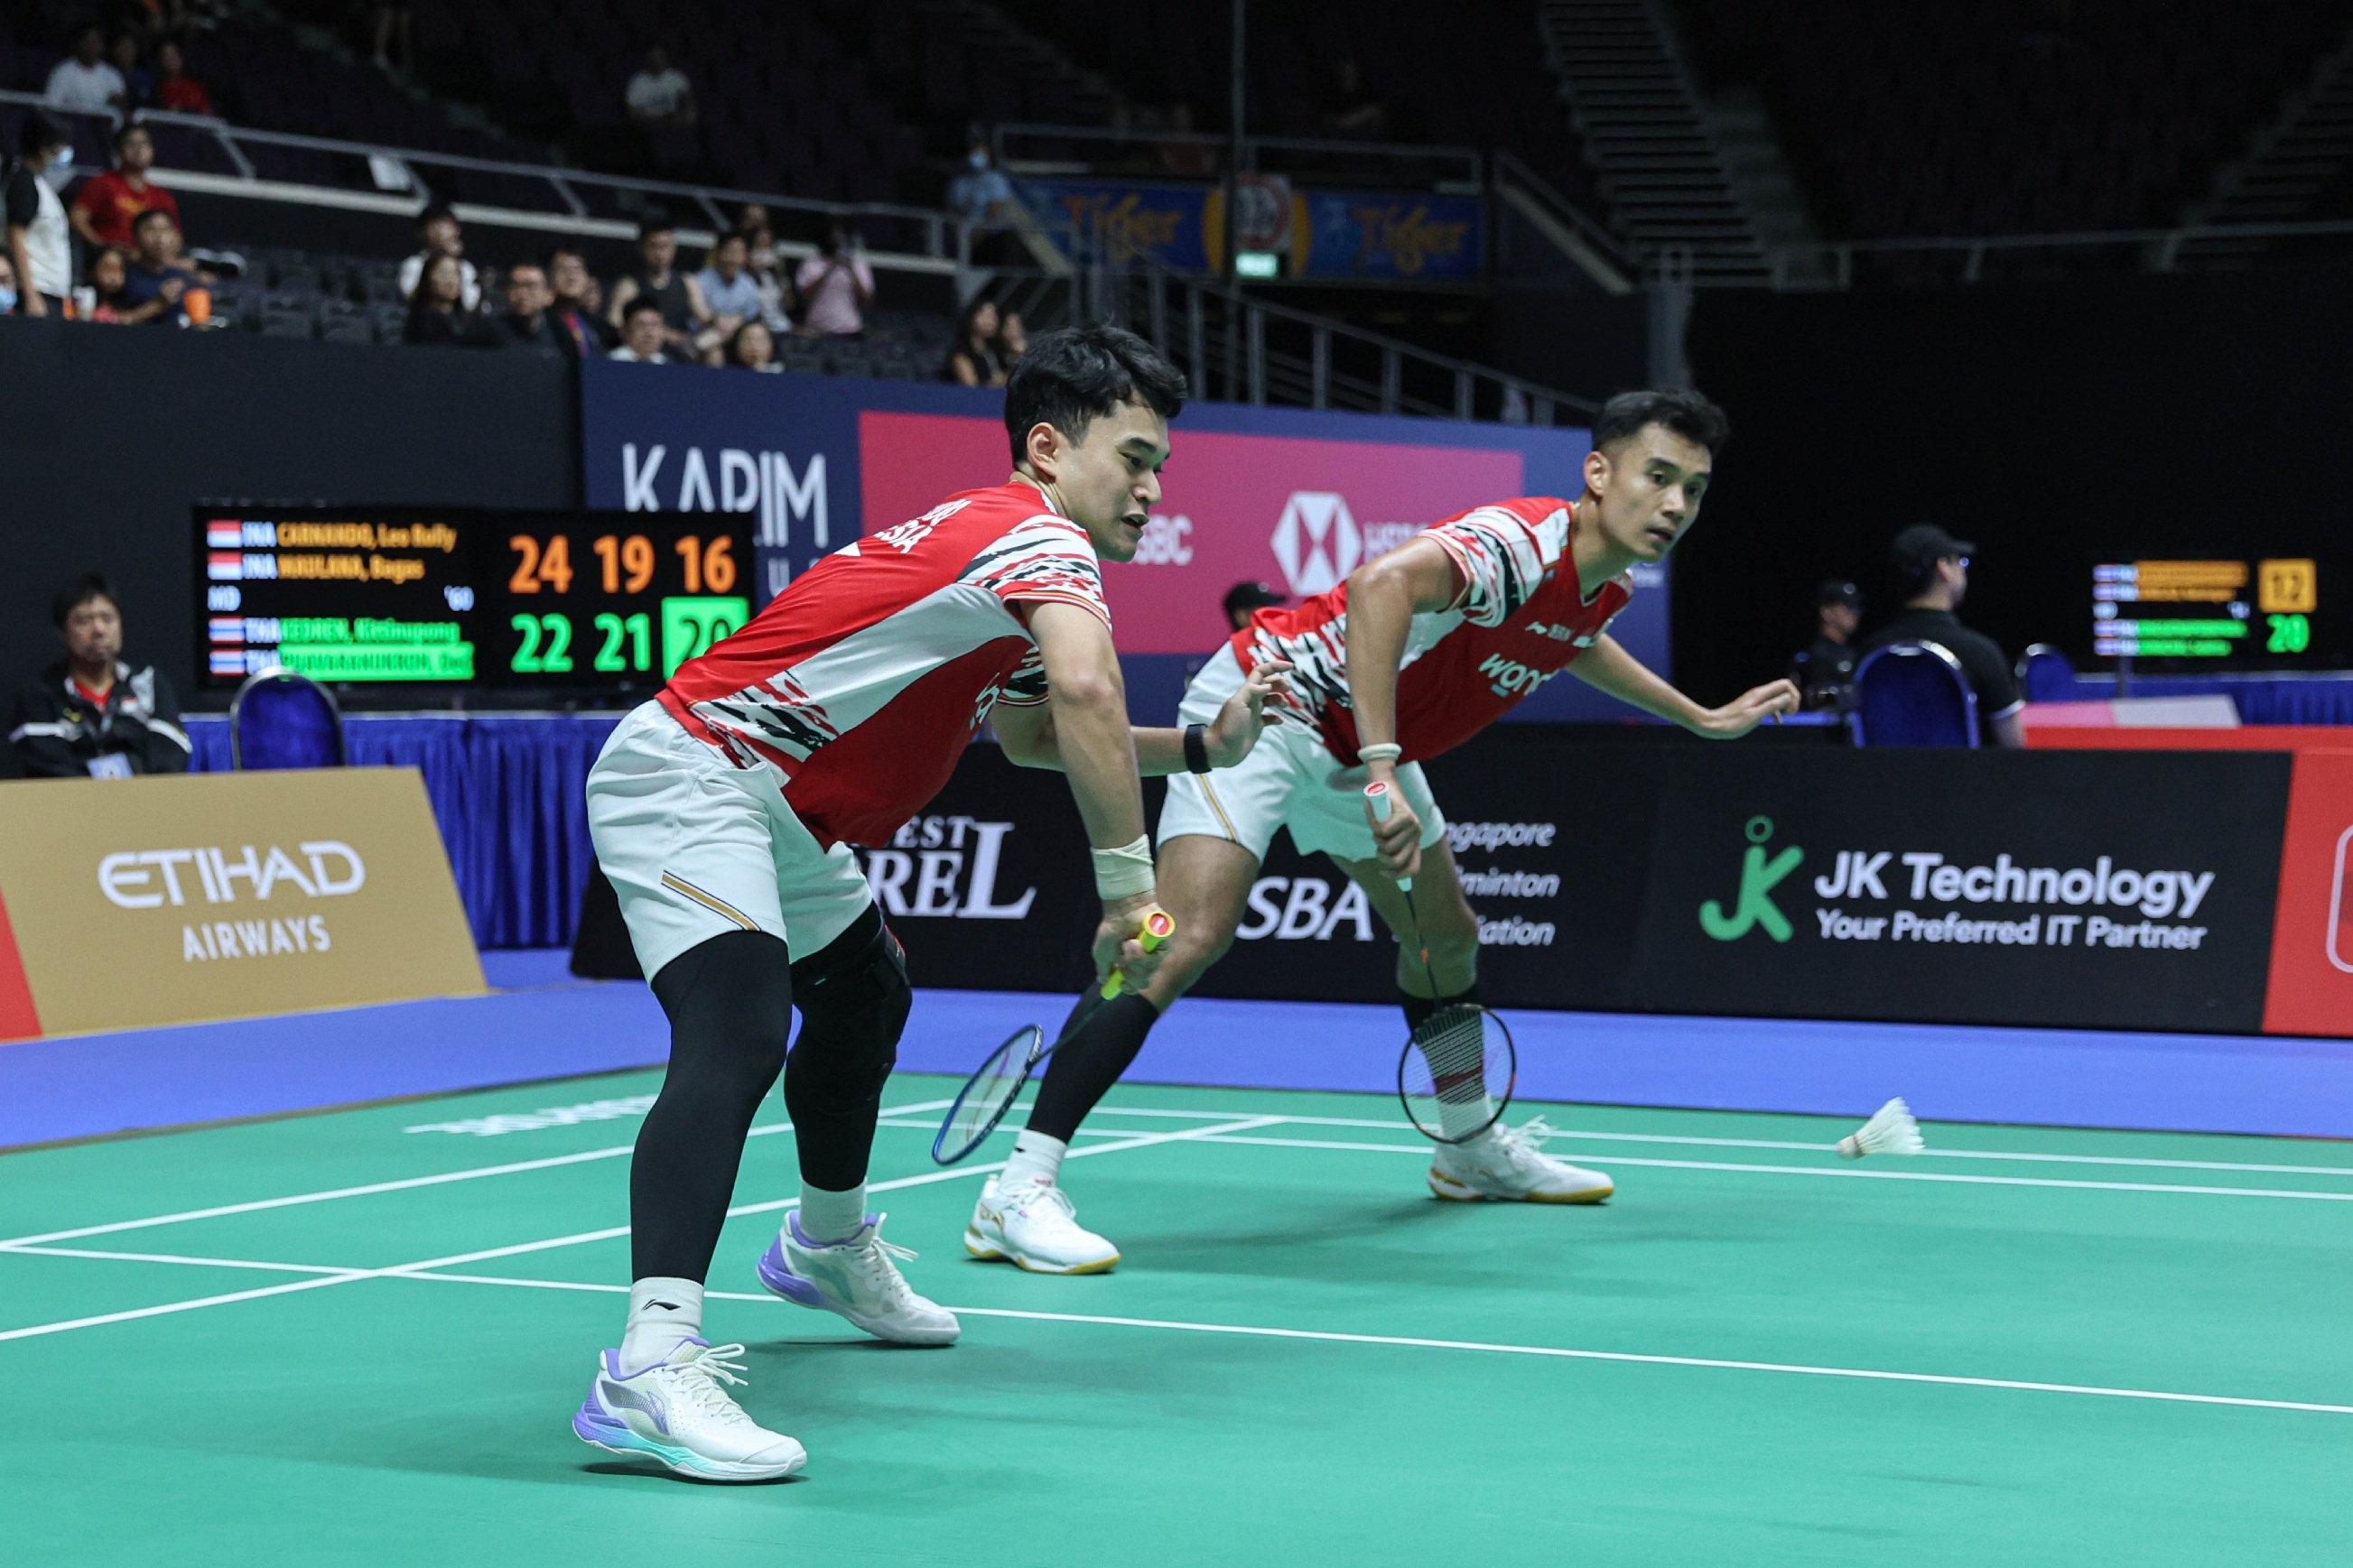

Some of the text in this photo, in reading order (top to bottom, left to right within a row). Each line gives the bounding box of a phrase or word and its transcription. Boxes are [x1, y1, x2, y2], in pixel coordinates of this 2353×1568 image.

[508, 534, 573, 594] 24
[593, 534, 655, 594] 19
[675, 534, 736, 594] 16
[1134, 515, 1193, 566] SBC
[511, 613, 573, 673] 22
[594, 613, 650, 672] 21
[894, 815, 977, 849] EST
[1445, 822, 1556, 853] ngapore
[98, 840, 366, 909] ETIHAD
[866, 821, 1037, 919] REL
[1456, 867, 1560, 897] minton
[1815, 850, 2216, 918] JK Technology
[1235, 877, 1374, 941] SBA
[1476, 915, 1556, 946] iation
[1816, 907, 2209, 950] Your Preferred IT Partner
[182, 914, 331, 962] AIRWAYS
